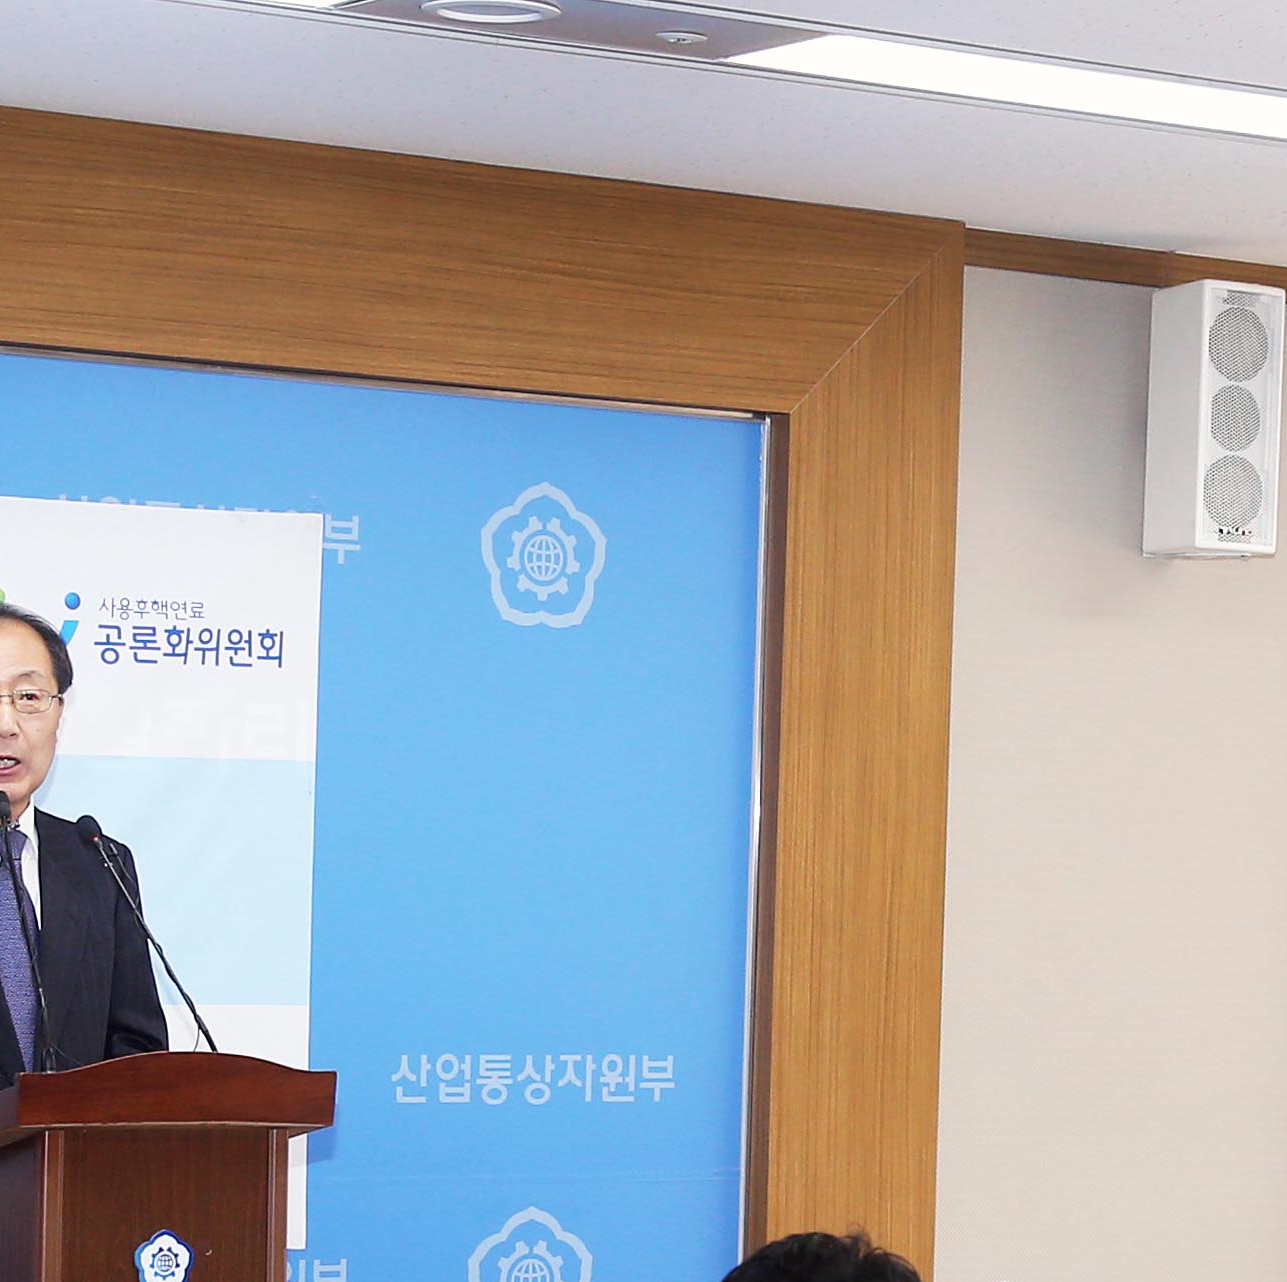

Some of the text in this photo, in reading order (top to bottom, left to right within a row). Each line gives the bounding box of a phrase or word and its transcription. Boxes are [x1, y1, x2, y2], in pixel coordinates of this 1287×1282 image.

[98, 597, 205, 621] 사용후핵연료
[94, 624, 284, 669] 공론화위원회
[391, 1053, 676, 1106] 산업통상자원부
